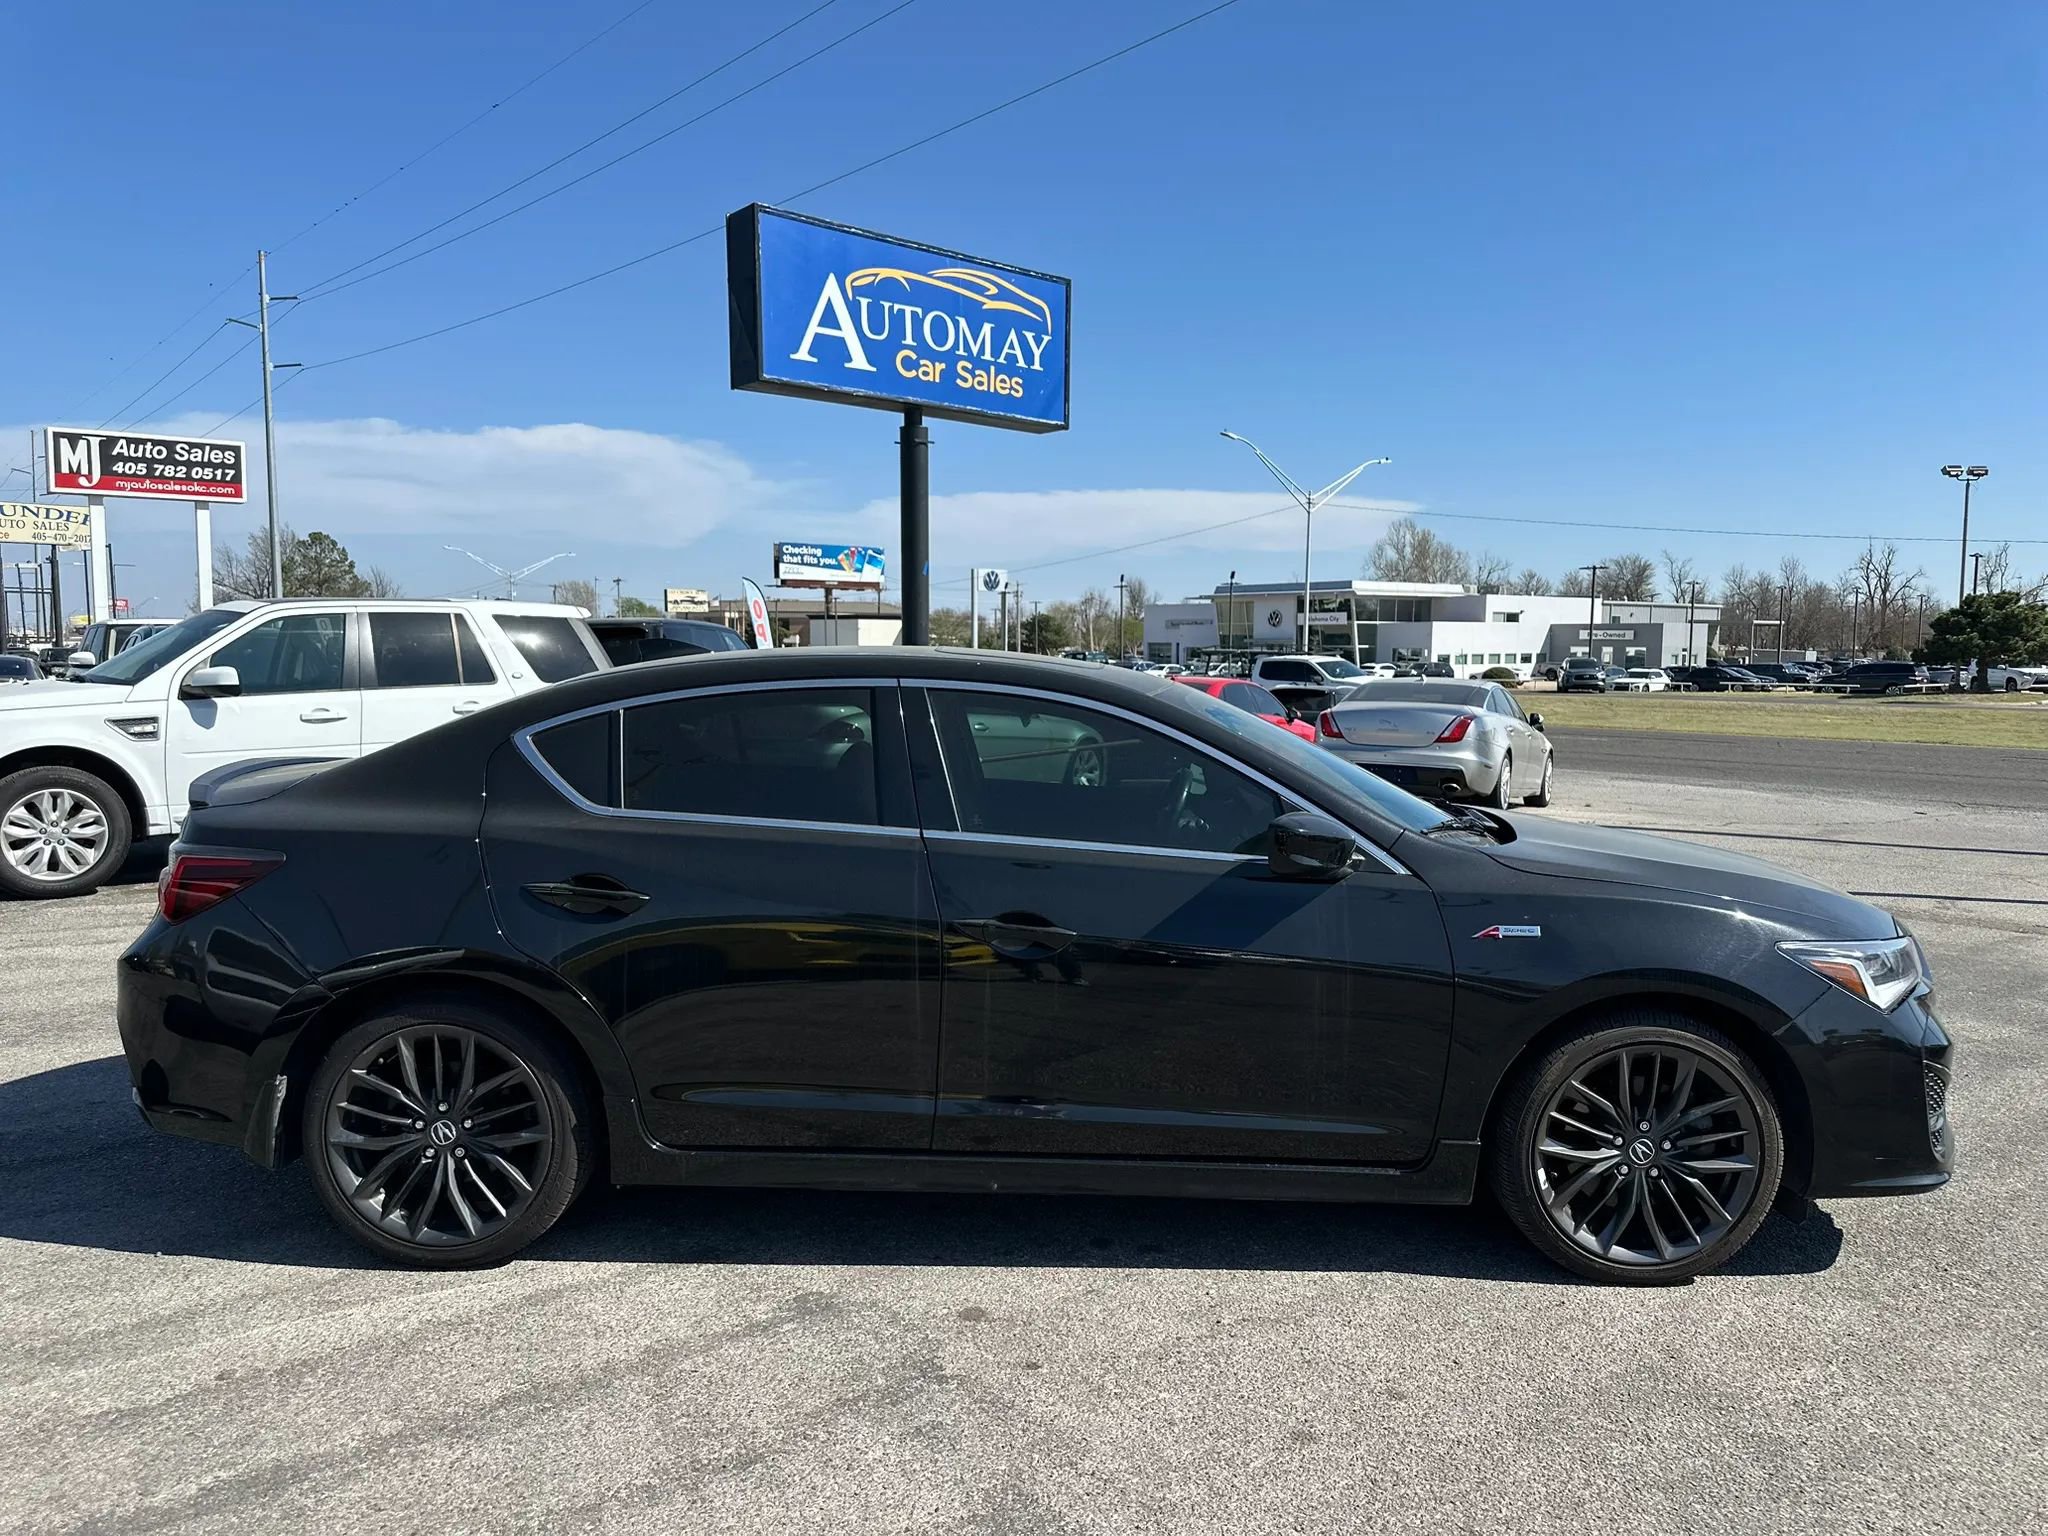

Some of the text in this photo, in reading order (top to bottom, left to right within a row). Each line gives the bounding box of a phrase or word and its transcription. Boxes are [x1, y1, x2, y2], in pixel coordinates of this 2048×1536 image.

[789, 272, 1052, 372] AUTOMAY
[895, 349, 1024, 398] Car Sales
[111, 439, 236, 465] Auto Sales
[59, 435, 107, 487] MJ
[112, 462, 236, 481] 405 782 0517
[115, 479, 236, 495] mjautosalesokc.com
[32, 520, 70, 532] SALES
[32, 531, 91, 544] 405-470-2017
[782, 545, 823, 556] Checking
[782, 554, 838, 566] that fits you.
